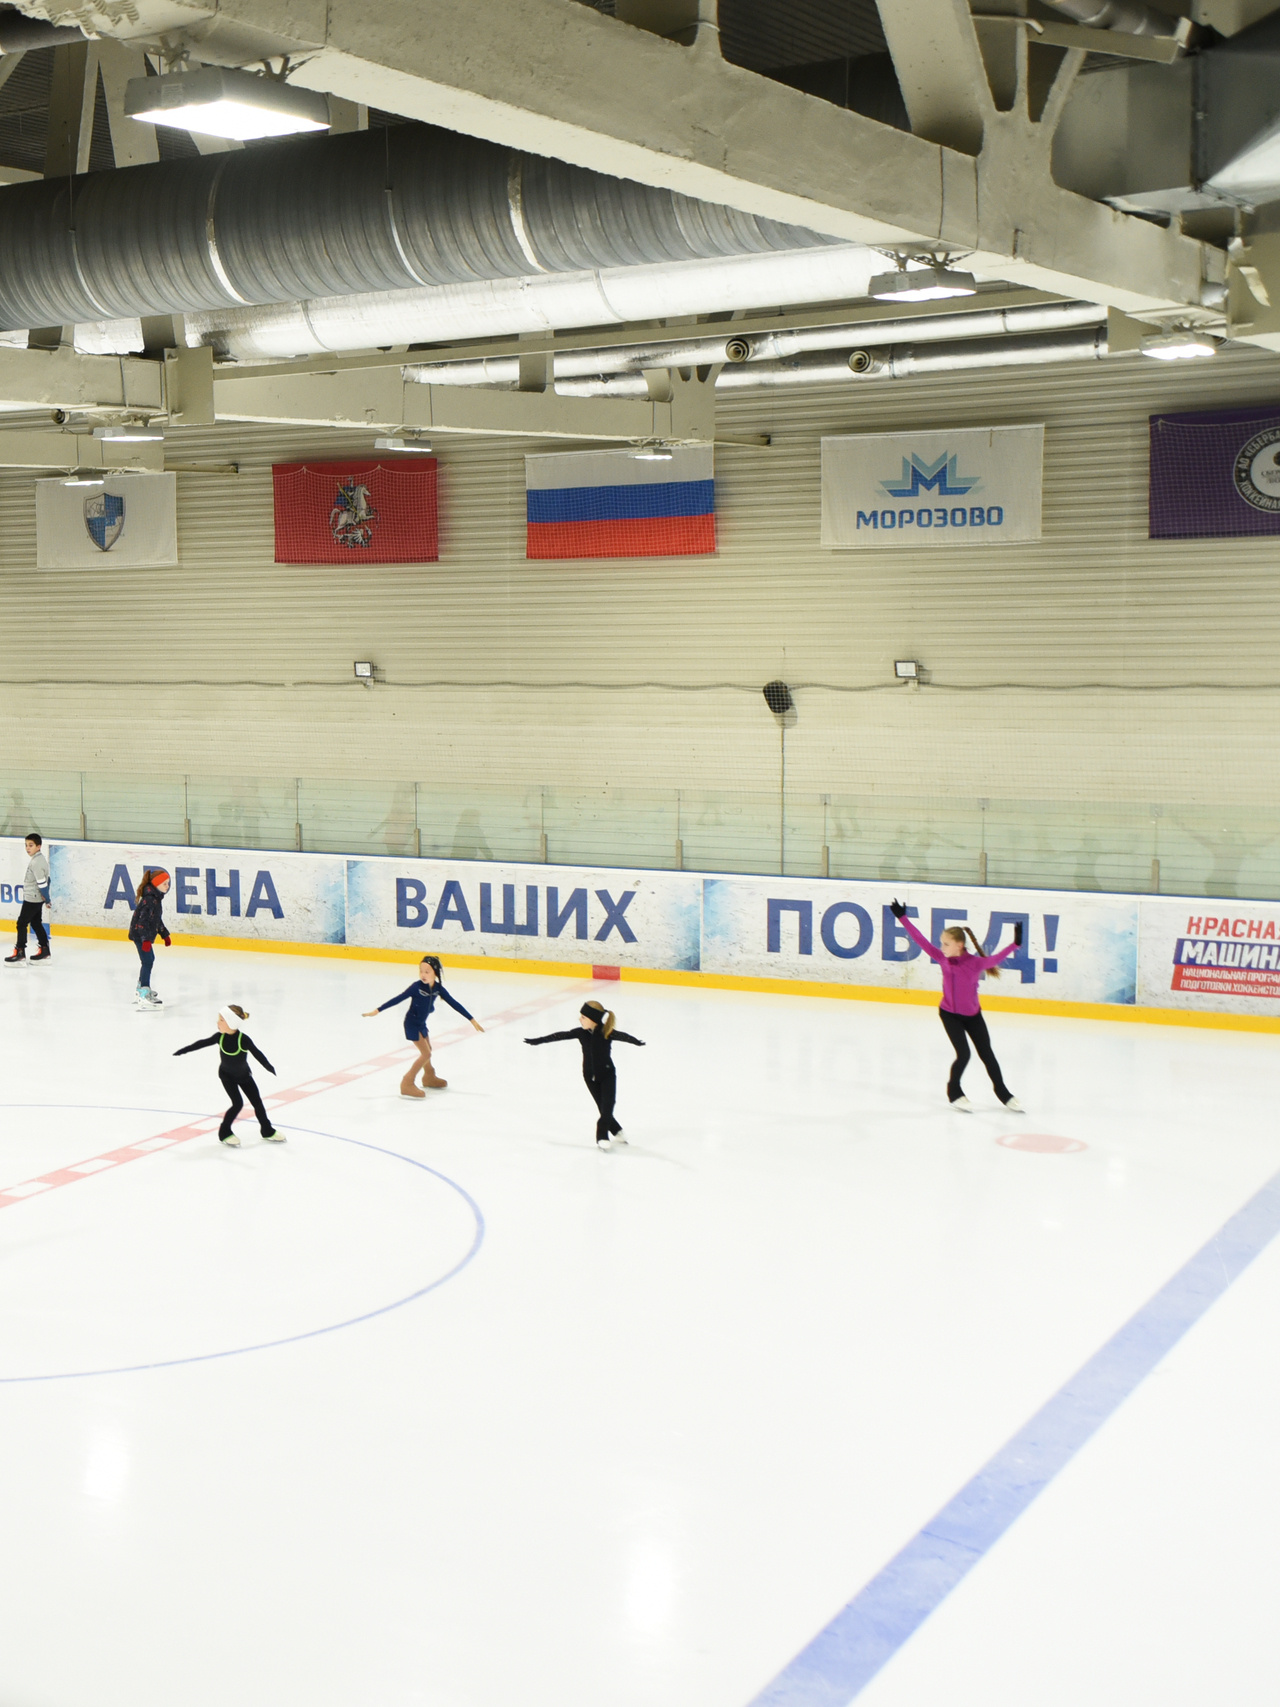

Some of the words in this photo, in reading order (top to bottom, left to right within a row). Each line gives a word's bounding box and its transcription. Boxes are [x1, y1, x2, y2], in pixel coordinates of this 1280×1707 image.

[1238, 480, 1280, 509] ХОККЕЙНА
[856, 506, 1003, 529] МОРОЗОВО
[396, 877, 638, 943] ВАШИХ
[1186, 916, 1280, 940] КРАСНА
[1180, 940, 1280, 970] МАШИН
[1180, 979, 1232, 992] ПОДГОТОВКИ
[1182, 967, 1247, 981] НАЦИОНАЛЬНАЯ
